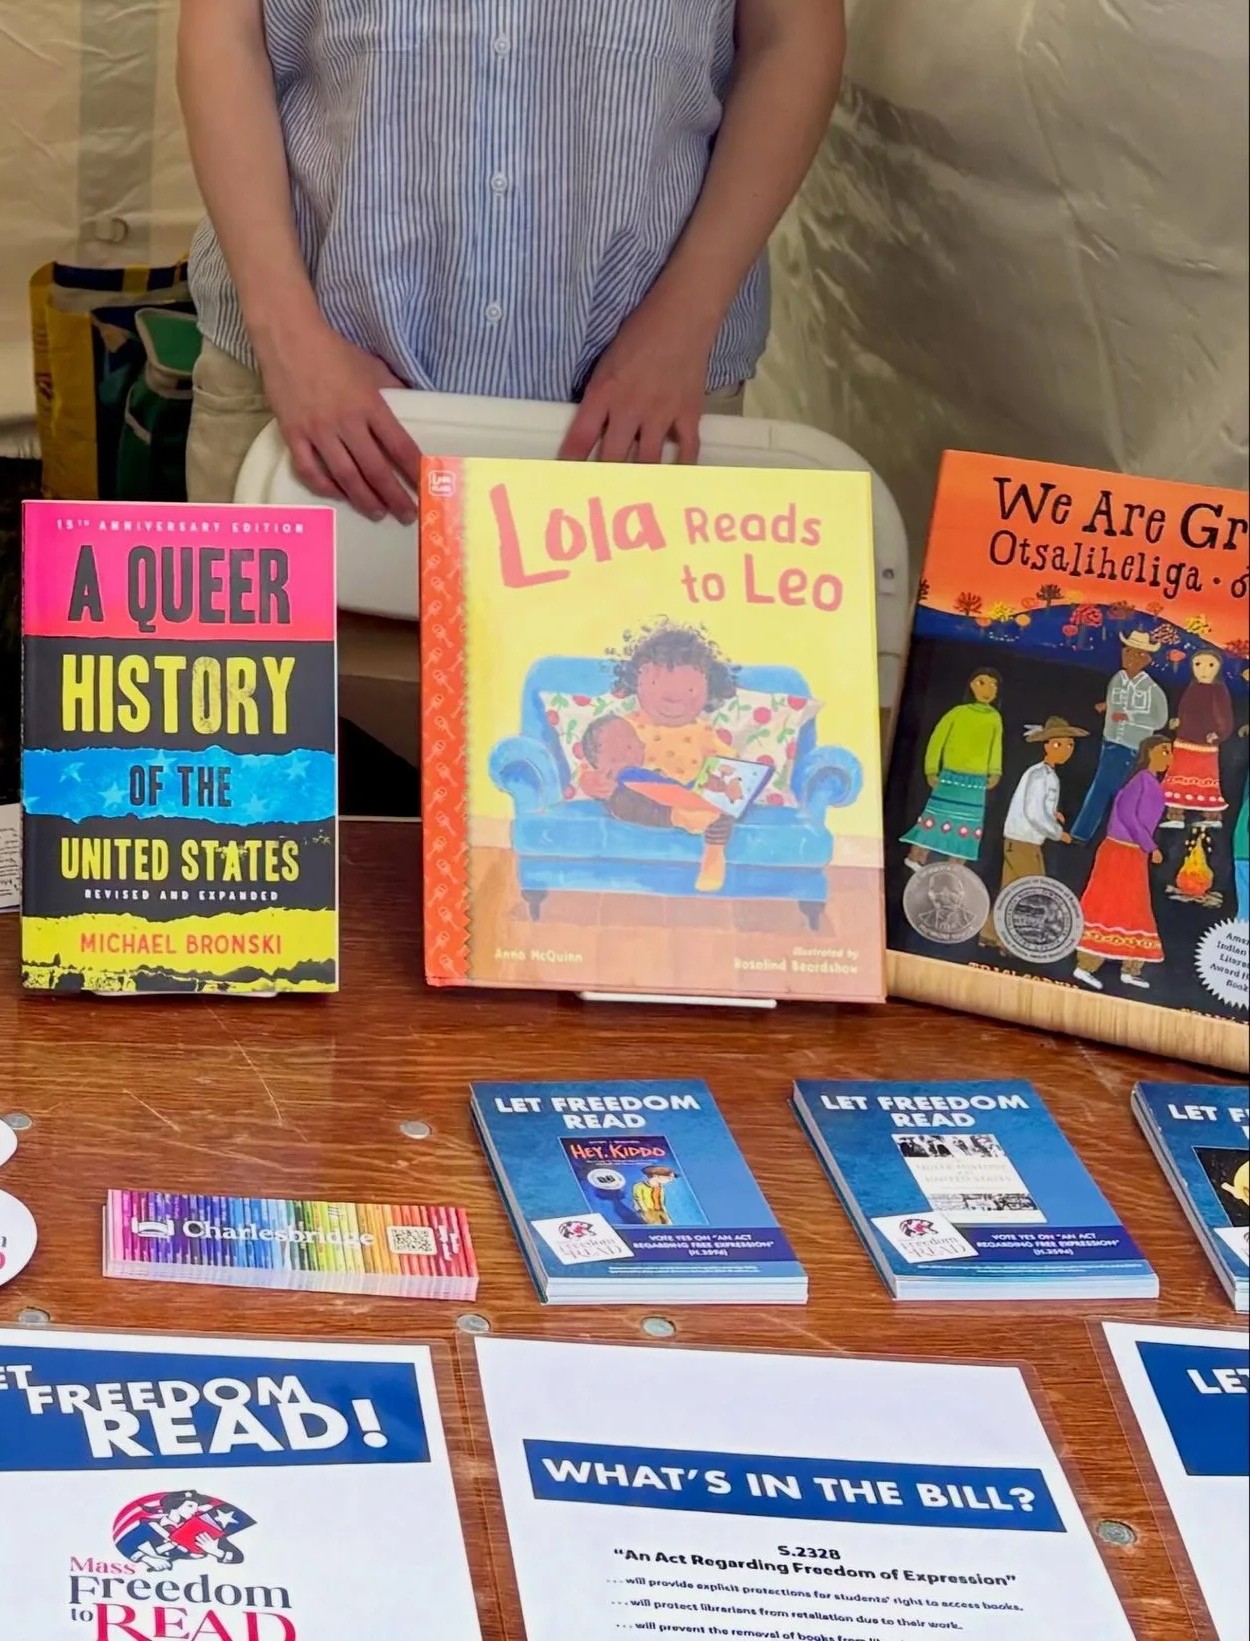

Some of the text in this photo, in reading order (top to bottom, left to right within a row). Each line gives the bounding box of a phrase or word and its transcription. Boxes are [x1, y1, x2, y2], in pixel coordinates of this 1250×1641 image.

[993, 476, 1072, 525] We
[1082, 490, 1166, 544] Are
[99, 521, 221, 533] ANNIVERSARY
[232, 522, 304, 534] EDITION
[490, 483, 822, 588] Lola Reads
[990, 530, 1203, 599] Otsaliheliga
[68, 544, 292, 633] A QUEER
[681, 553, 844, 612] to Leo
[62, 654, 296, 734] HISTORY
[129, 765, 232, 807] OF THE
[61, 837, 169, 881] UNITED
[181, 840, 299, 882] STATES
[85, 889, 279, 901] REVISED AND EXPANDED
[80, 933, 282, 955] MICHAEL BRONSKI
[494, 1095, 701, 1113] LET FREEDOM
[820, 1094, 1030, 1111] LET FREEDOM
[1168, 1104, 1217, 1121] LET
[563, 1113, 646, 1129] READ
[891, 1112, 976, 1128] READ
[610, 1144, 666, 1158] KIDDO
[183, 1221, 374, 1247] Charlesbridge
[24, 1375, 313, 1415] FREEDOM
[82, 1397, 389, 1459] READ!
[746, 1471, 802, 1500] IN
[813, 1476, 904, 1507] THE
[916, 1482, 1037, 1512] BILL?
[70, 1556, 136, 1576] Mass
[655, 1552, 688, 1565] Act
[690, 1554, 790, 1575] Regarding
[792, 1562, 876, 1579] Freedom
[879, 1569, 899, 1580] of
[777, 1545, 841, 1560] S.2328
[68, 1573, 293, 1610] Freedom
[648, 1579, 694, 1589] provide
[696, 1582, 740, 1593] explicit
[742, 1586, 812, 1598] protections
[814, 1591, 831, 1599] for
[893, 1597, 924, 1607] right
[925, 1598, 940, 1607] to
[942, 1601, 981, 1609] access
[71, 1602, 297, 1641] to READ
